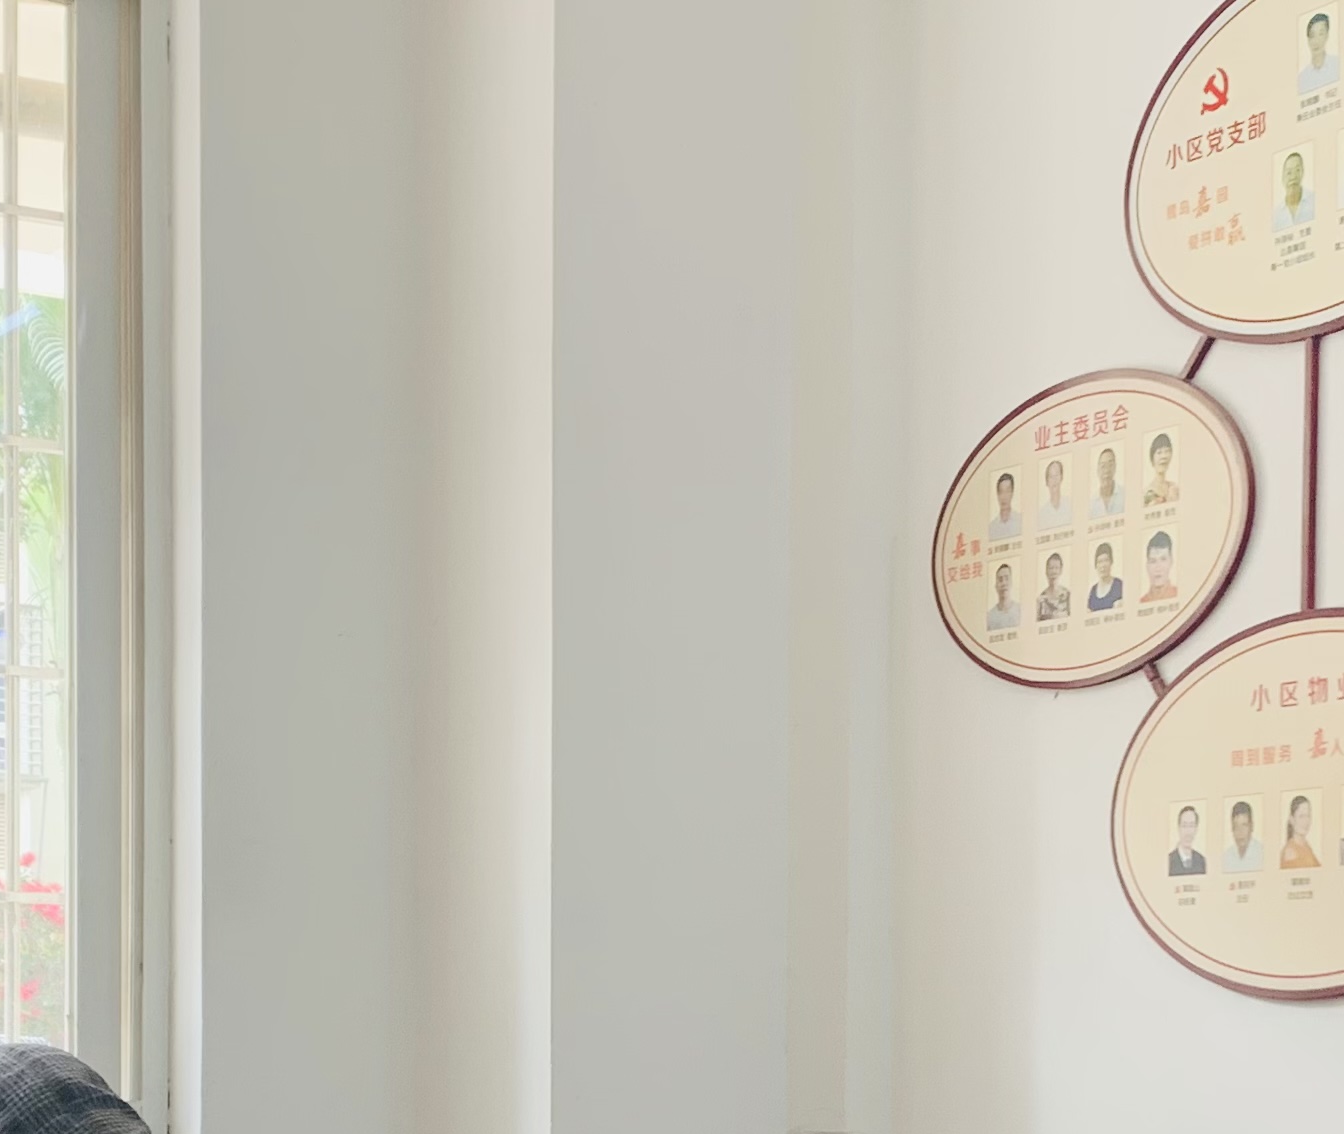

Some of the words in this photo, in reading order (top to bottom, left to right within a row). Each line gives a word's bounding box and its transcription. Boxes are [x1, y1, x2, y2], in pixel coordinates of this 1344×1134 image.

[1165, 111, 1267, 170] 小区党支部
[1033, 404, 1130, 451] 业主委员会
